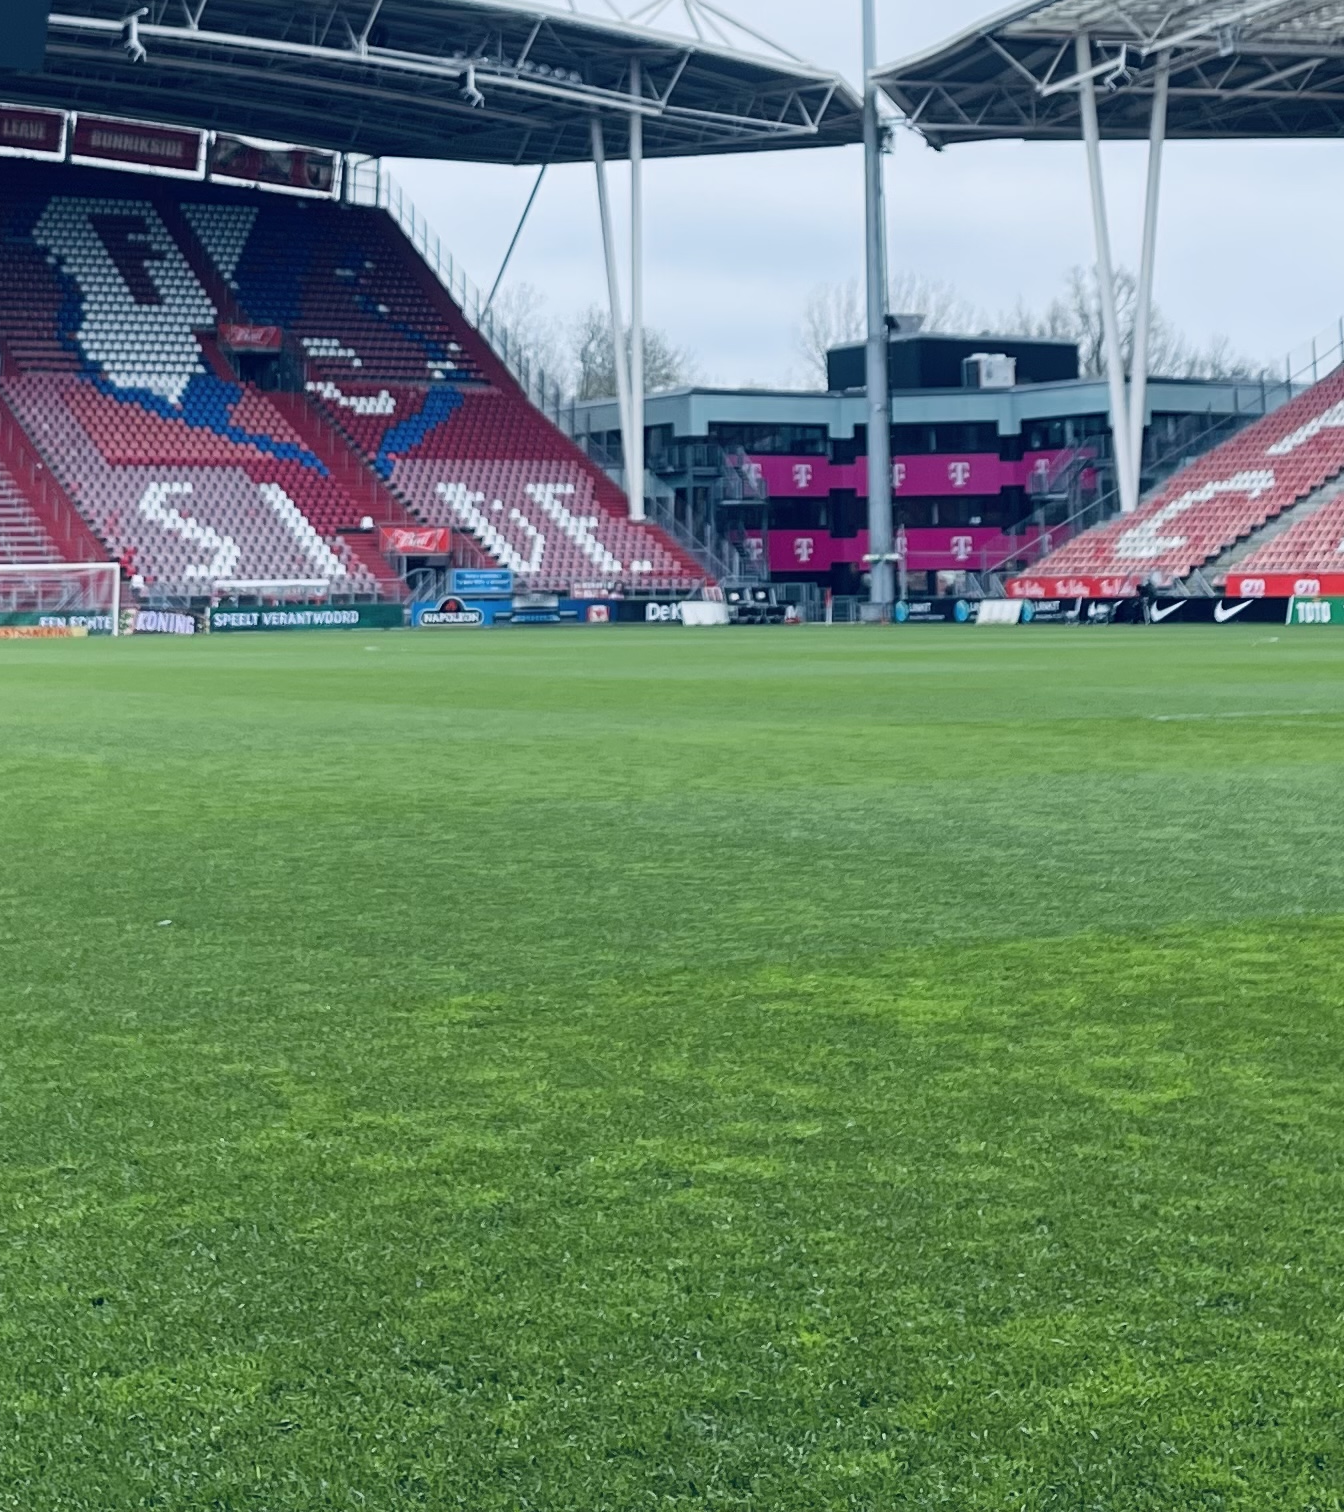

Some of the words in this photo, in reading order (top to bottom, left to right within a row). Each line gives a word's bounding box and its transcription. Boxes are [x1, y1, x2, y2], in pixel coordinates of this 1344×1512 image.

[2, 118, 46, 140] LEAVE
[135, 610, 195, 634] KONING
[213, 612, 259, 628] SPEELT
[262, 610, 359, 626] VERANTWOORD
[423, 612, 480, 623] NAPOLEON
[1296, 601, 1332, 623] TOTO
